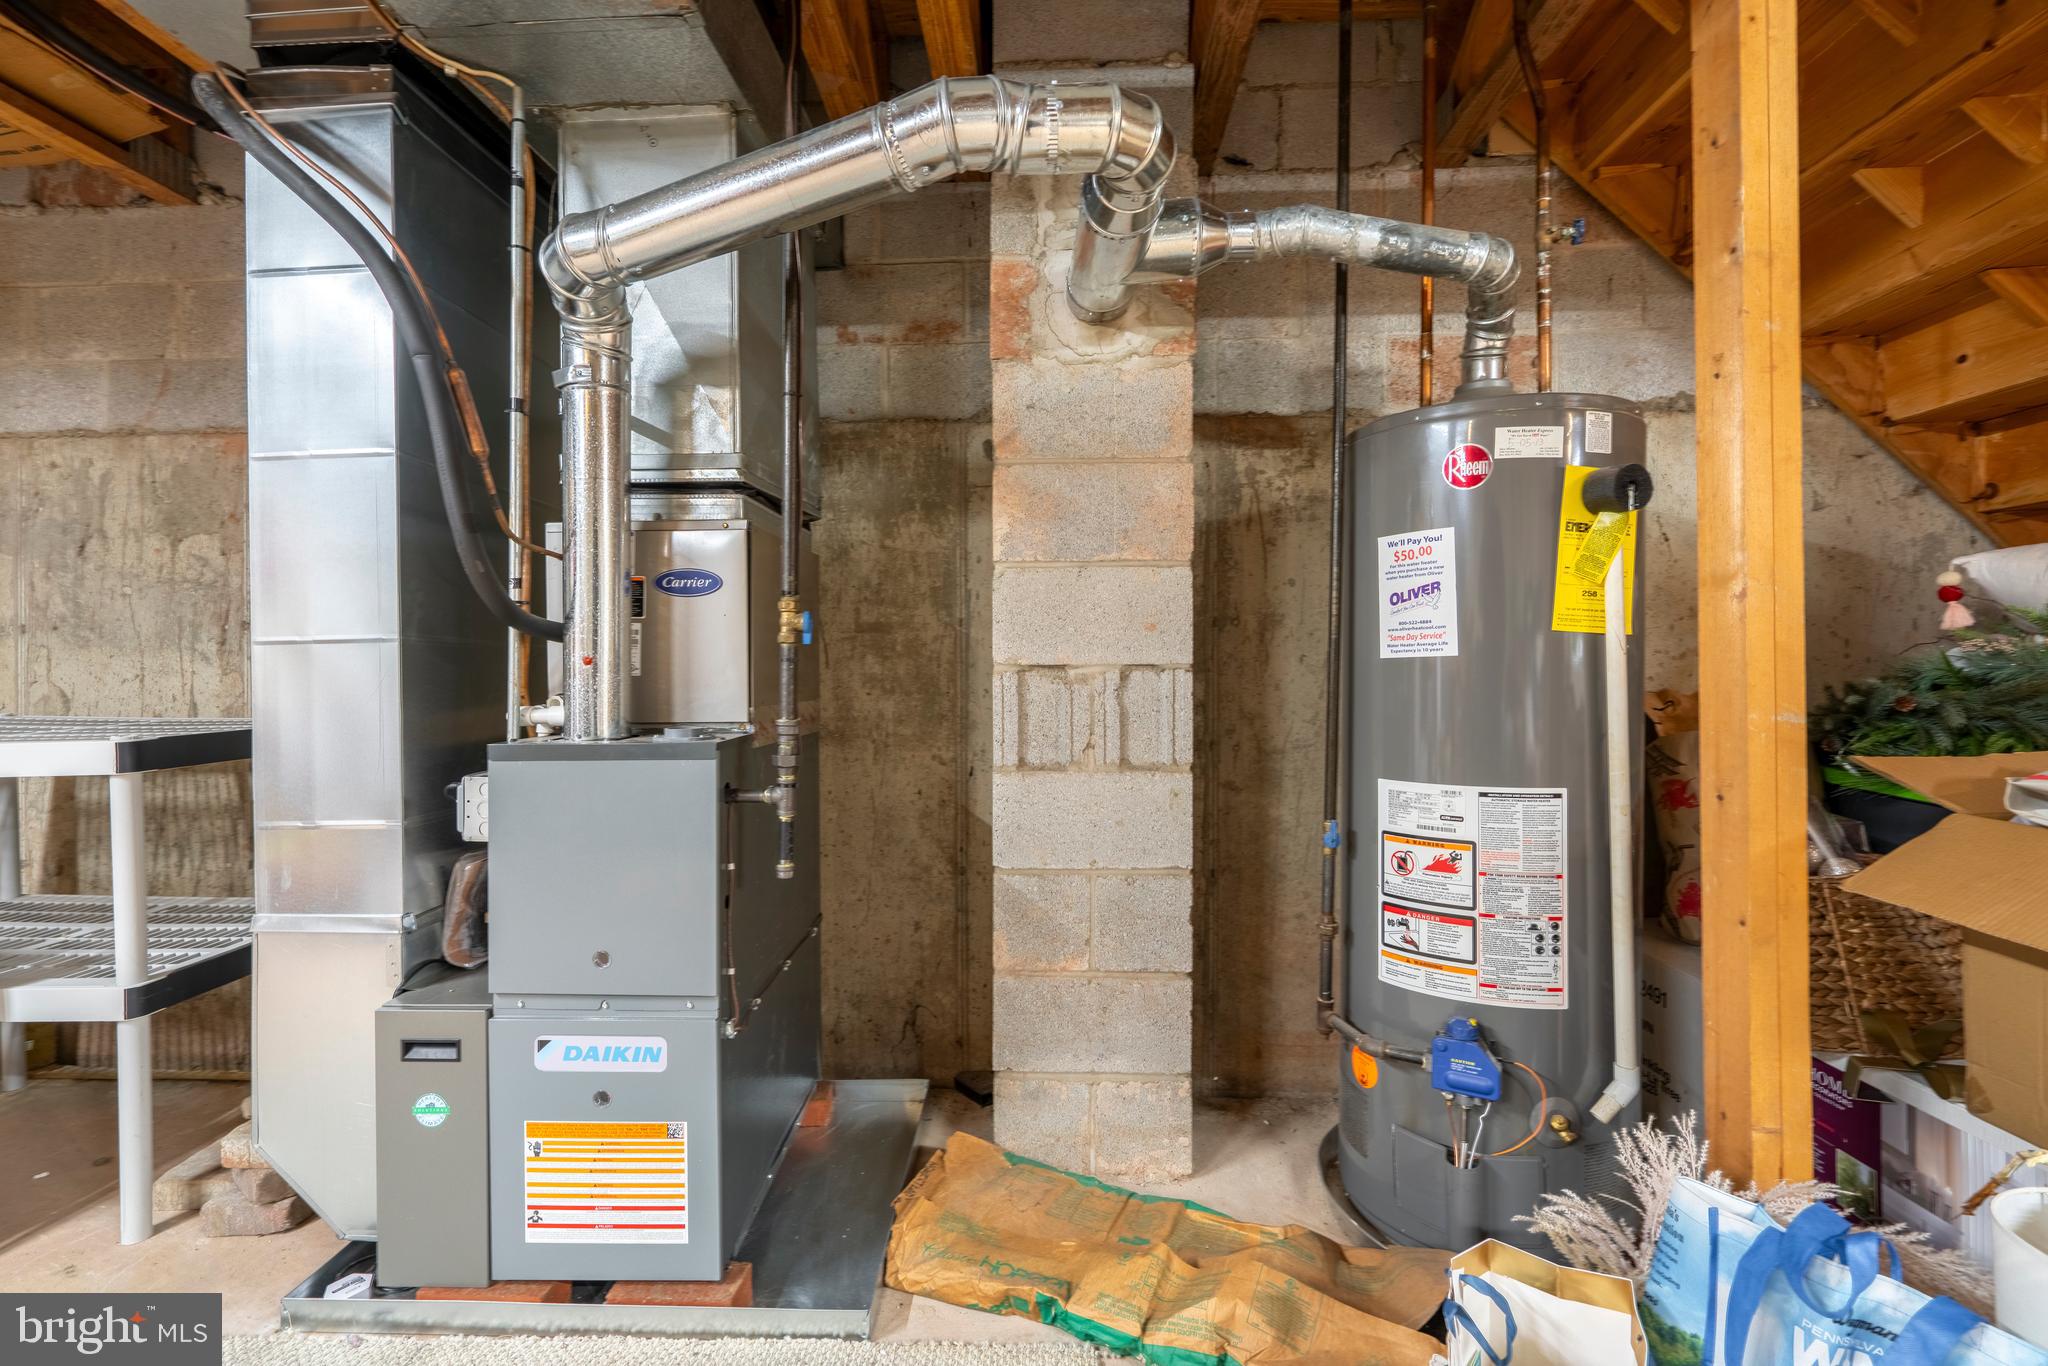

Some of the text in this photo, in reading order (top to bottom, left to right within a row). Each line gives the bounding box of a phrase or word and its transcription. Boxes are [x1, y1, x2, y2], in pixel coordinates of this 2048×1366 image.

[1448, 453, 1489, 483] Rheem
[1387, 534, 1443, 548] We'll Pay You!
[1393, 545, 1433, 564] $50.00
[661, 576, 713, 588] Carrier
[1389, 580, 1442, 606] OLIVER
[1406, 633, 1419, 641] Day
[1412, 912, 1441, 922] DANGER
[562, 1045, 663, 1063] DAIKIN
